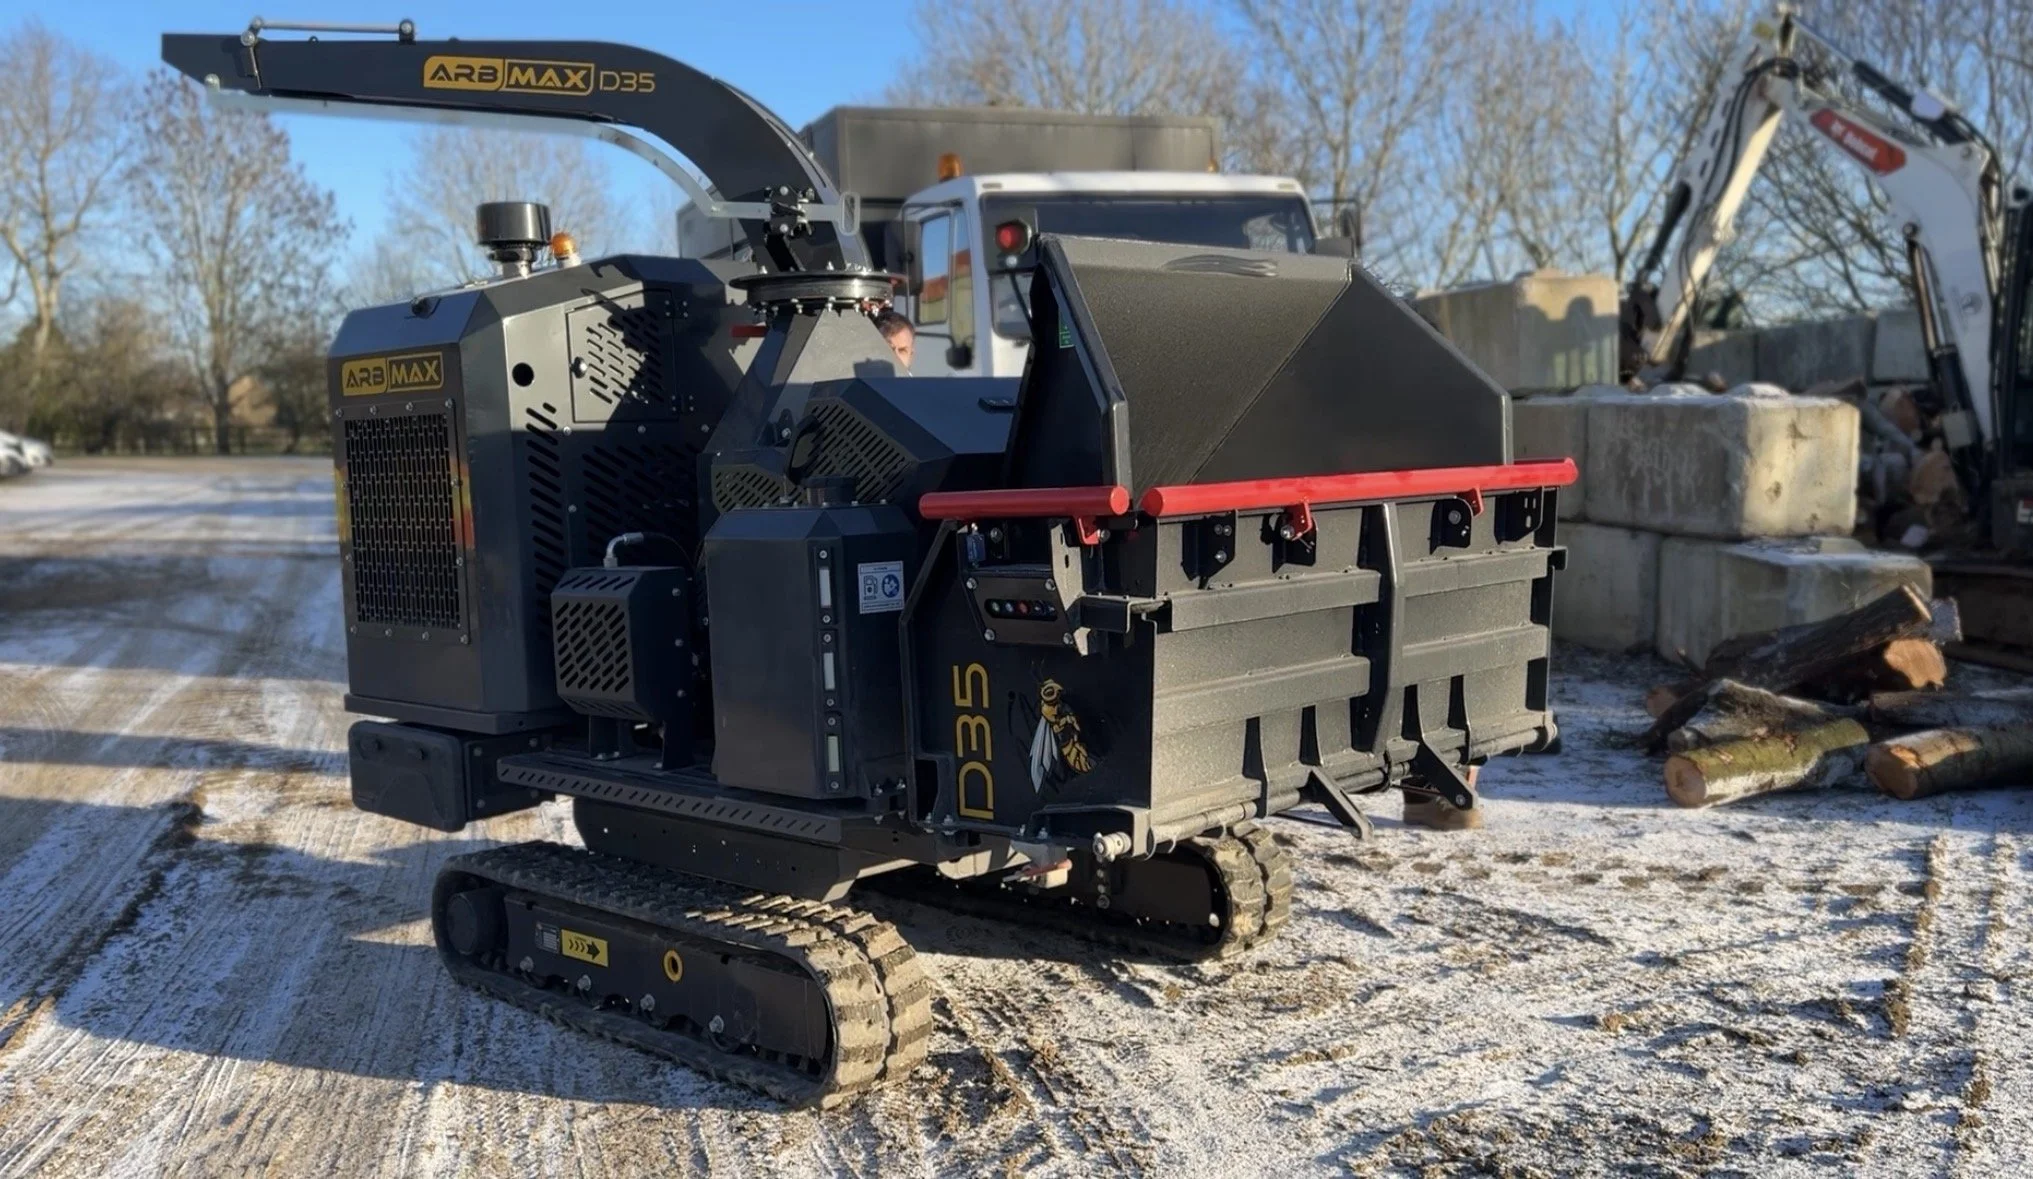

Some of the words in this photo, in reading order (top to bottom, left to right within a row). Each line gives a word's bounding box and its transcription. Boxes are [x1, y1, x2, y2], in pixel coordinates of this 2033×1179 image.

[430, 63, 498, 83] ARB
[508, 66, 587, 89] MAX
[600, 70, 656, 93] D35
[346, 366, 385, 389] ARB
[392, 359, 440, 385] MAX
[953, 662, 994, 820] D35
